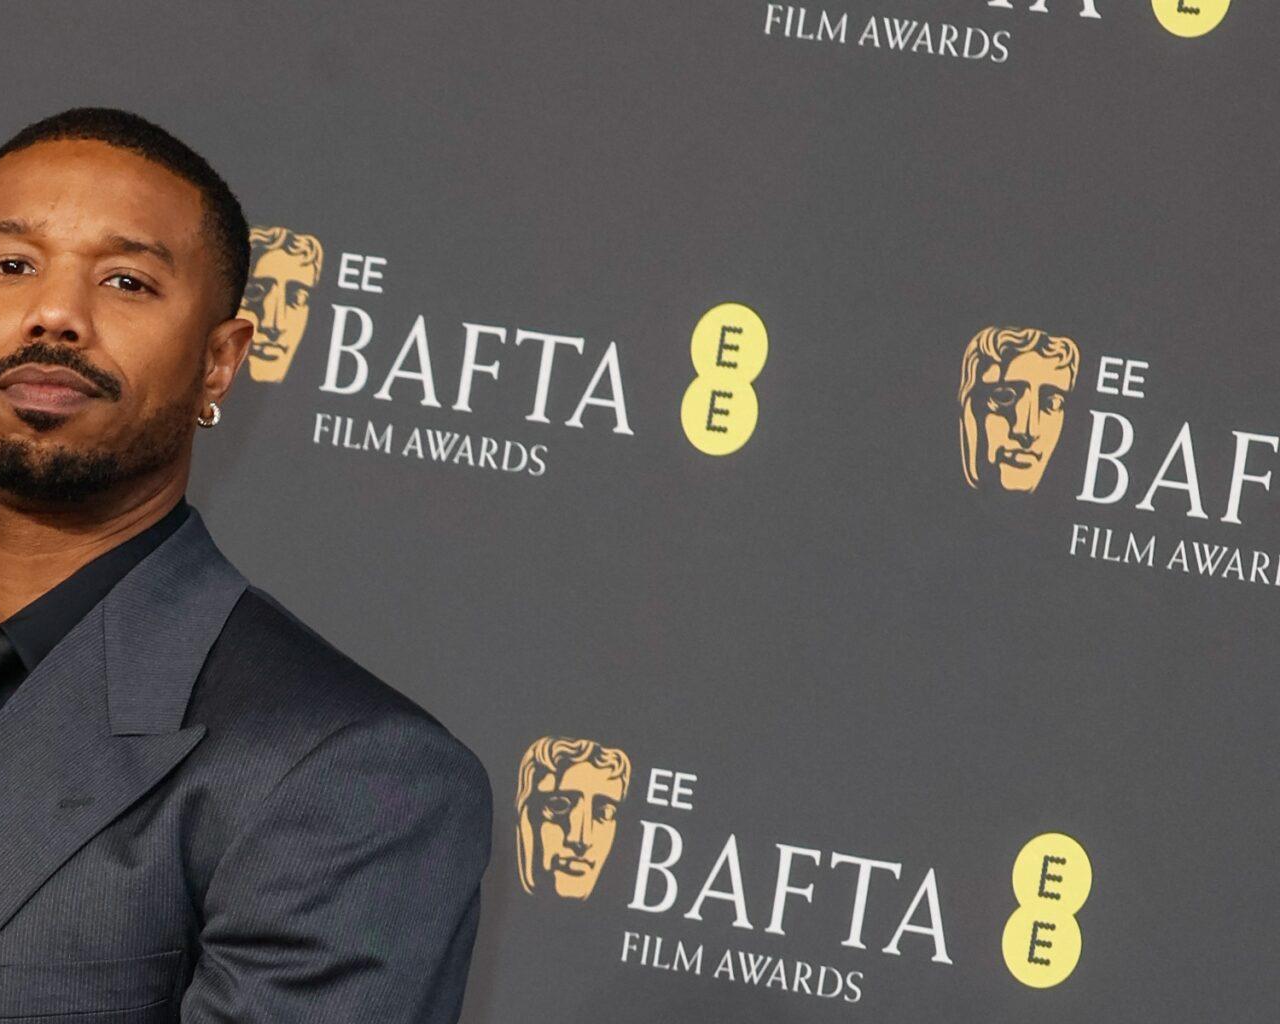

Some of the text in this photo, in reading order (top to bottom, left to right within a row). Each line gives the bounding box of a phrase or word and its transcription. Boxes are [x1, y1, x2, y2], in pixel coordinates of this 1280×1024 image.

[764, 3, 1011, 63] FILM AWARDS
[337, 252, 388, 294] EE
[318, 303, 635, 436] BAFTA
[1095, 355, 1150, 399] EE
[312, 412, 548, 476] FILM AWARDS
[1069, 523, 1280, 588] FILM AWAR
[646, 767, 698, 811] EE
[626, 819, 954, 965] BAFTA
[620, 930, 864, 1003] FILM AWARDS
